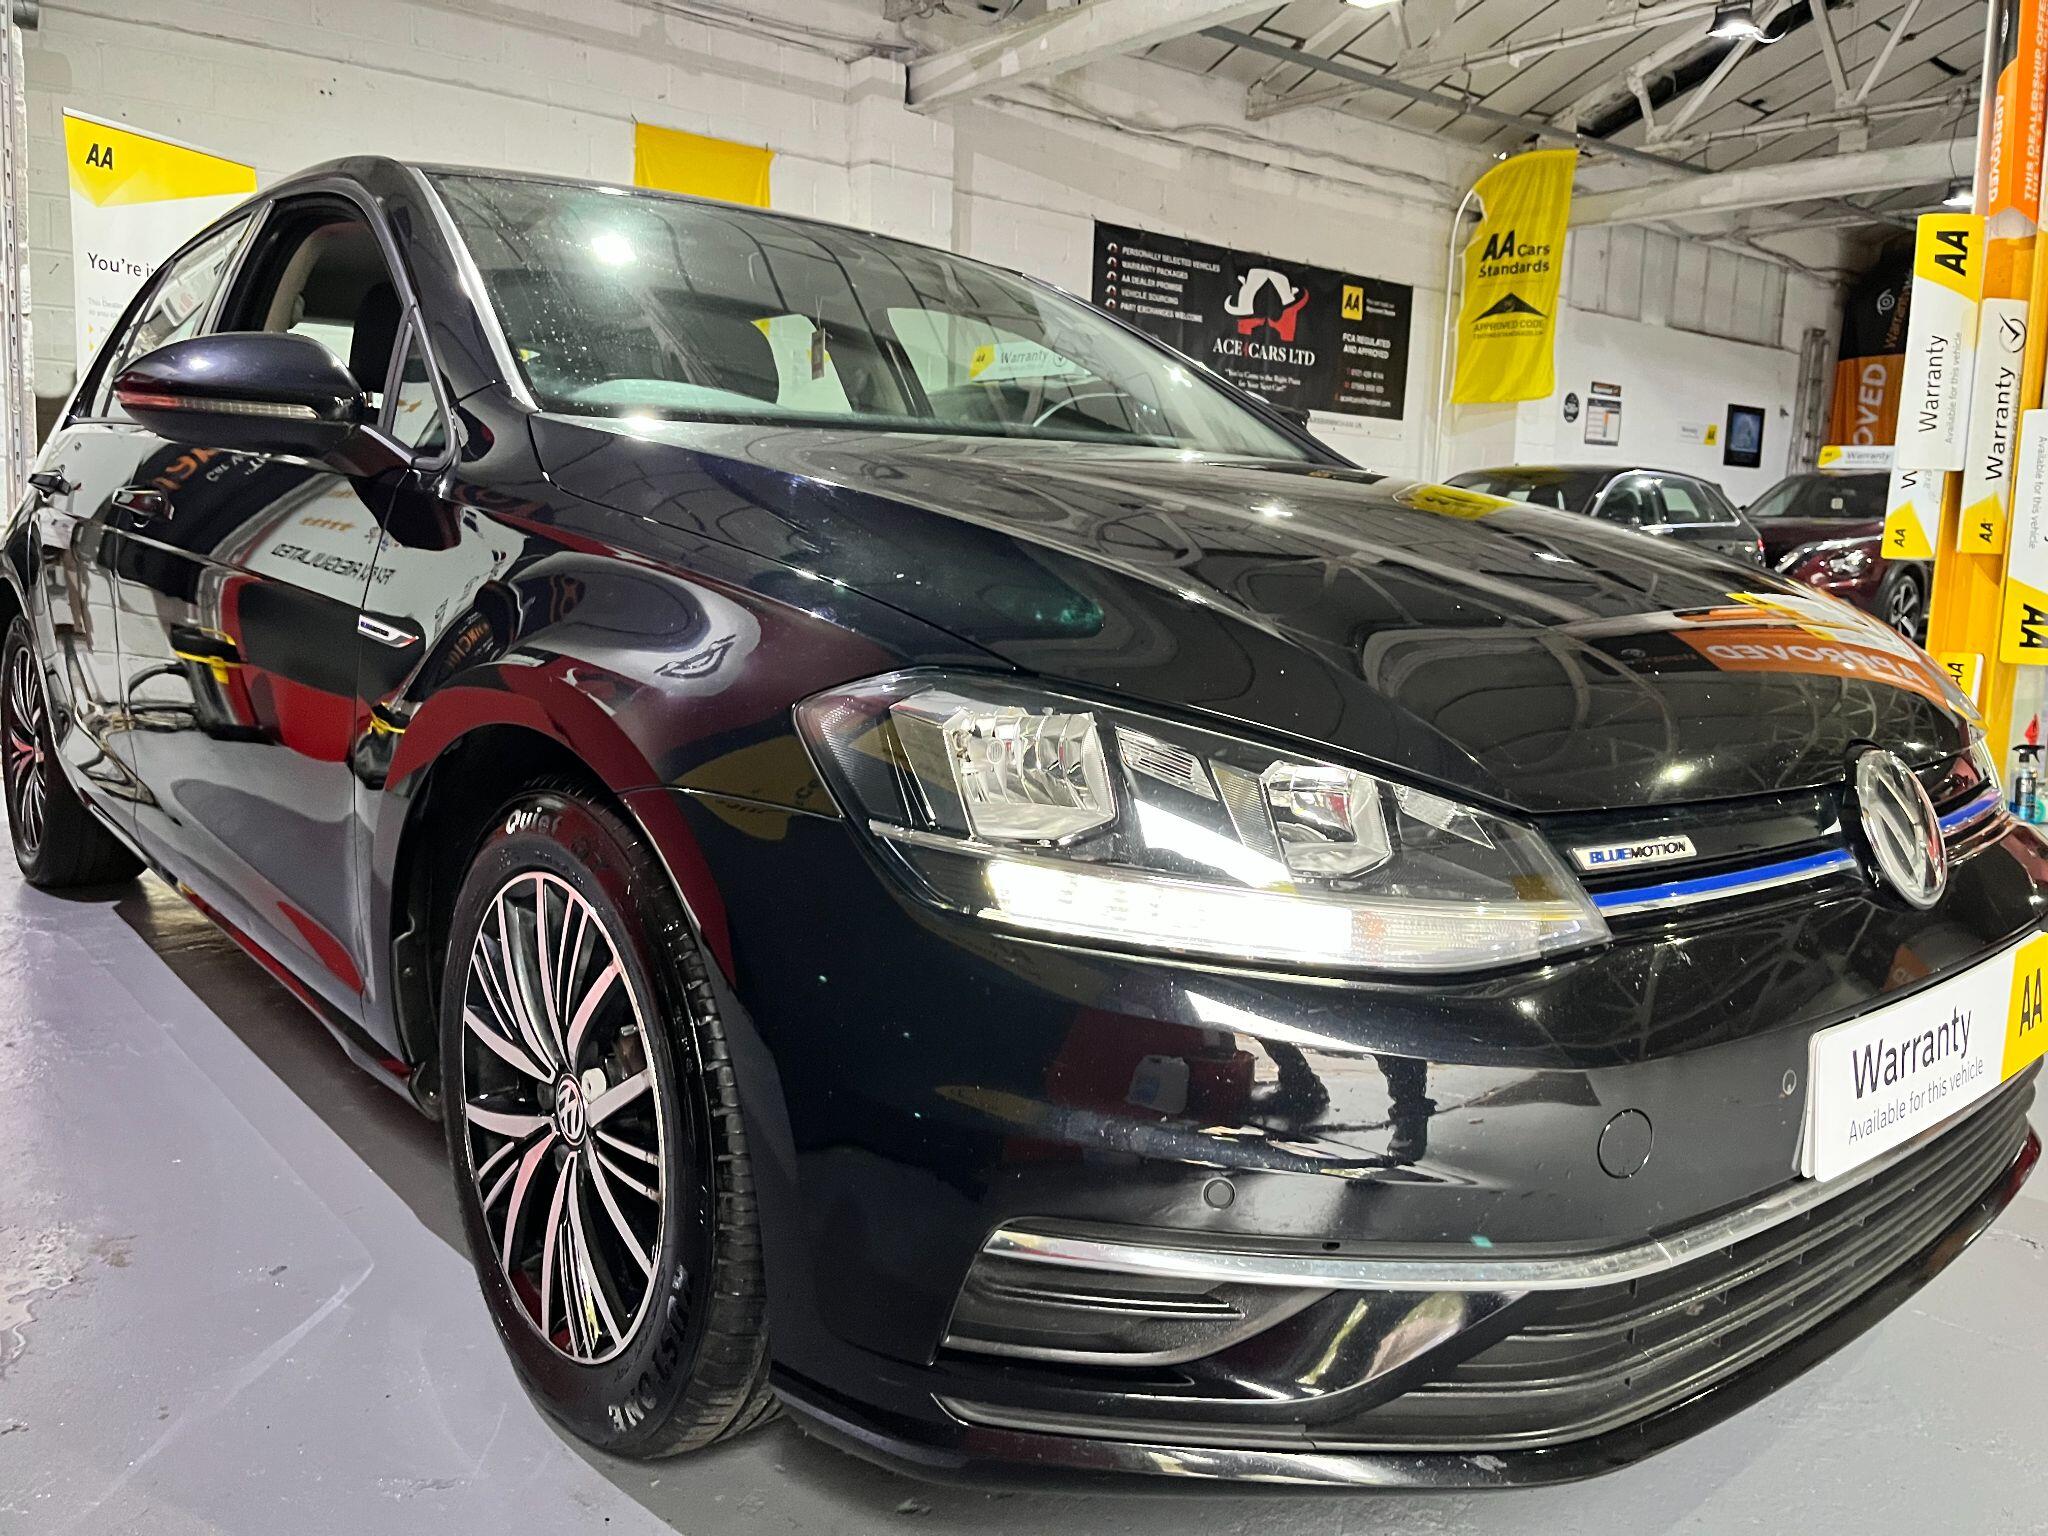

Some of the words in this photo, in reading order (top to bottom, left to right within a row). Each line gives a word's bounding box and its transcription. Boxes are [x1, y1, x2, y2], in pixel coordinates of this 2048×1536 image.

[2026, 48, 2041, 158] DEALERSHIP
[85, 143, 114, 171] AA
[1989, 95, 2004, 203] APPROVED
[2024, 160, 2034, 201] THIS
[1482, 230, 1516, 262] AA
[1517, 244, 1550, 258] Cars
[1934, 230, 1969, 277] AA
[88, 252, 142, 277] You're
[1121, 260, 1156, 274] WARRANTY
[1122, 246, 1162, 261] PERSONALLY
[1162, 253, 1192, 268] SELECTED
[1193, 260, 1221, 273] VEHICLES
[1478, 260, 1550, 279] Standards
[1121, 273, 1132, 283] AA
[1131, 275, 1156, 288] DEALER
[1120, 288, 1148, 301] VEHICLE
[1344, 293, 1361, 312] AA
[1119, 302, 1137, 313] PART
[1473, 322, 1519, 332] APPROVED
[1519, 319, 1544, 329] CODE
[1212, 337, 1243, 356] ACE
[1248, 341, 1287, 362] CARS
[1288, 348, 1316, 367] LTD
[1342, 332, 1356, 343] FCA
[1356, 334, 1392, 350] REGULATED
[1343, 344, 1357, 355] AND
[1357, 346, 1390, 360] APPROVED
[1952, 332, 1962, 366] vehicle
[1001, 351, 1048, 364] Warranty
[1918, 335, 1949, 433] Warranty
[1950, 367, 1960, 385] this
[1949, 386, 1959, 400] for
[1944, 401, 1957, 444] Available
[1985, 366, 2016, 481] Warranty
[1847, 451, 1890, 462] Warranty
[2034, 435, 2048, 479] Available
[2033, 480, 2043, 496] for
[2031, 496, 2043, 514] this
[1894, 528, 1907, 547] AA
[1979, 521, 1993, 543] AA
[2029, 514, 2040, 549] vehicle
[2019, 603, 2048, 648] AA
[1588, 841, 1686, 865] BLUEMOTION
[2019, 967, 2043, 1038] AA
[1852, 1005, 1972, 1100] Warranty
[1848, 1098, 1906, 1145] Available
[1909, 1090, 1926, 1115] for
[1926, 1080, 1947, 1106] this
[1949, 1056, 1984, 1093] vehicle
